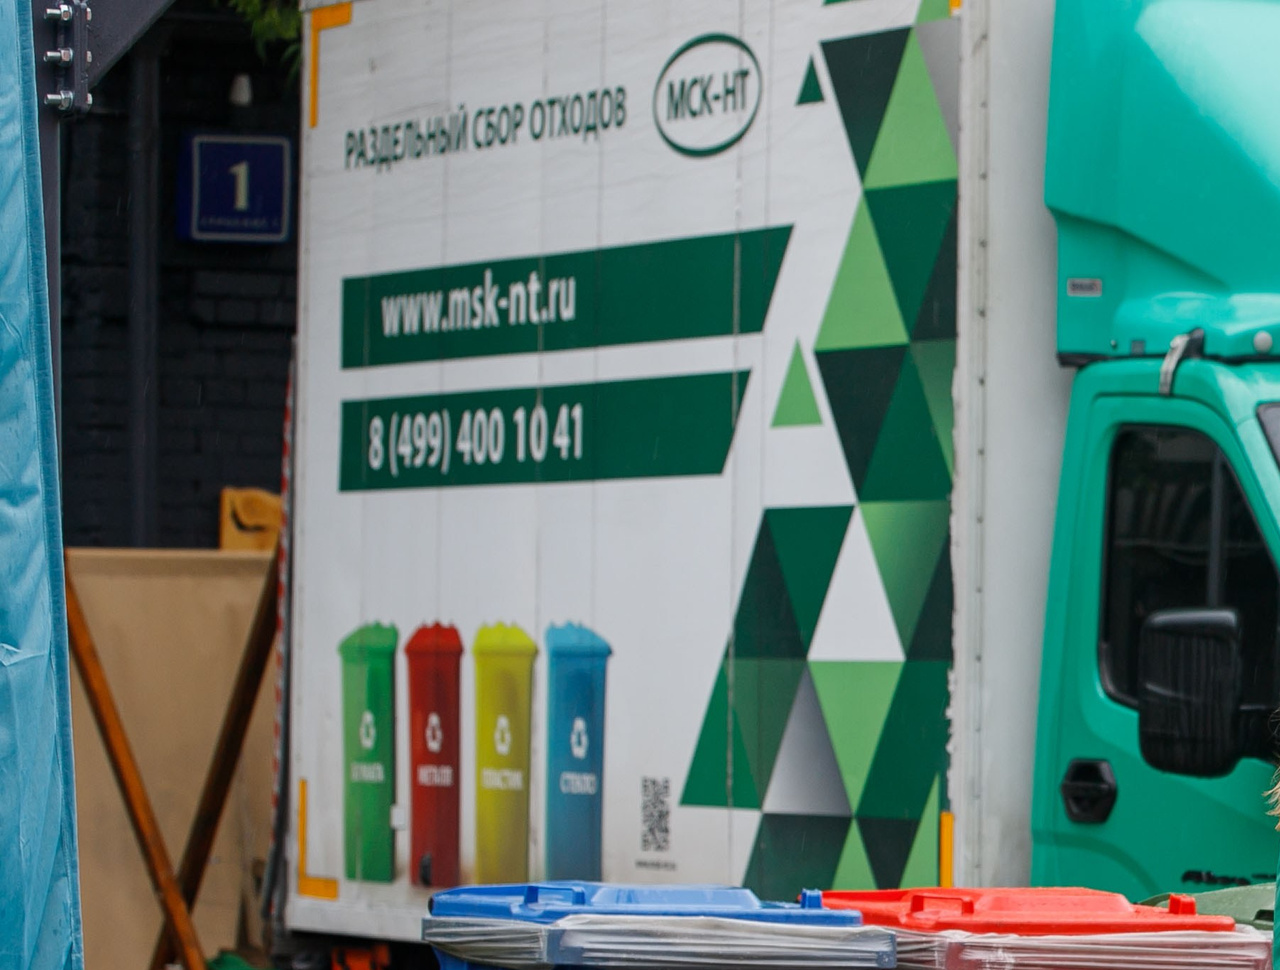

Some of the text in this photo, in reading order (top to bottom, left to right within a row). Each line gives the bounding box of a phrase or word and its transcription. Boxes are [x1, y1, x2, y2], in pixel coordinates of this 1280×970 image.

[344, 86, 627, 173] РАЗДЕЛЬНЫЙ СБОР ОТХОДОВ
[666, 68, 750, 123] МСК-НТ
[228, 160, 249, 212] 1
[381, 268, 576, 337] www.msk-nt.ru
[368, 402, 583, 478] 8 (499) 400 10 41
